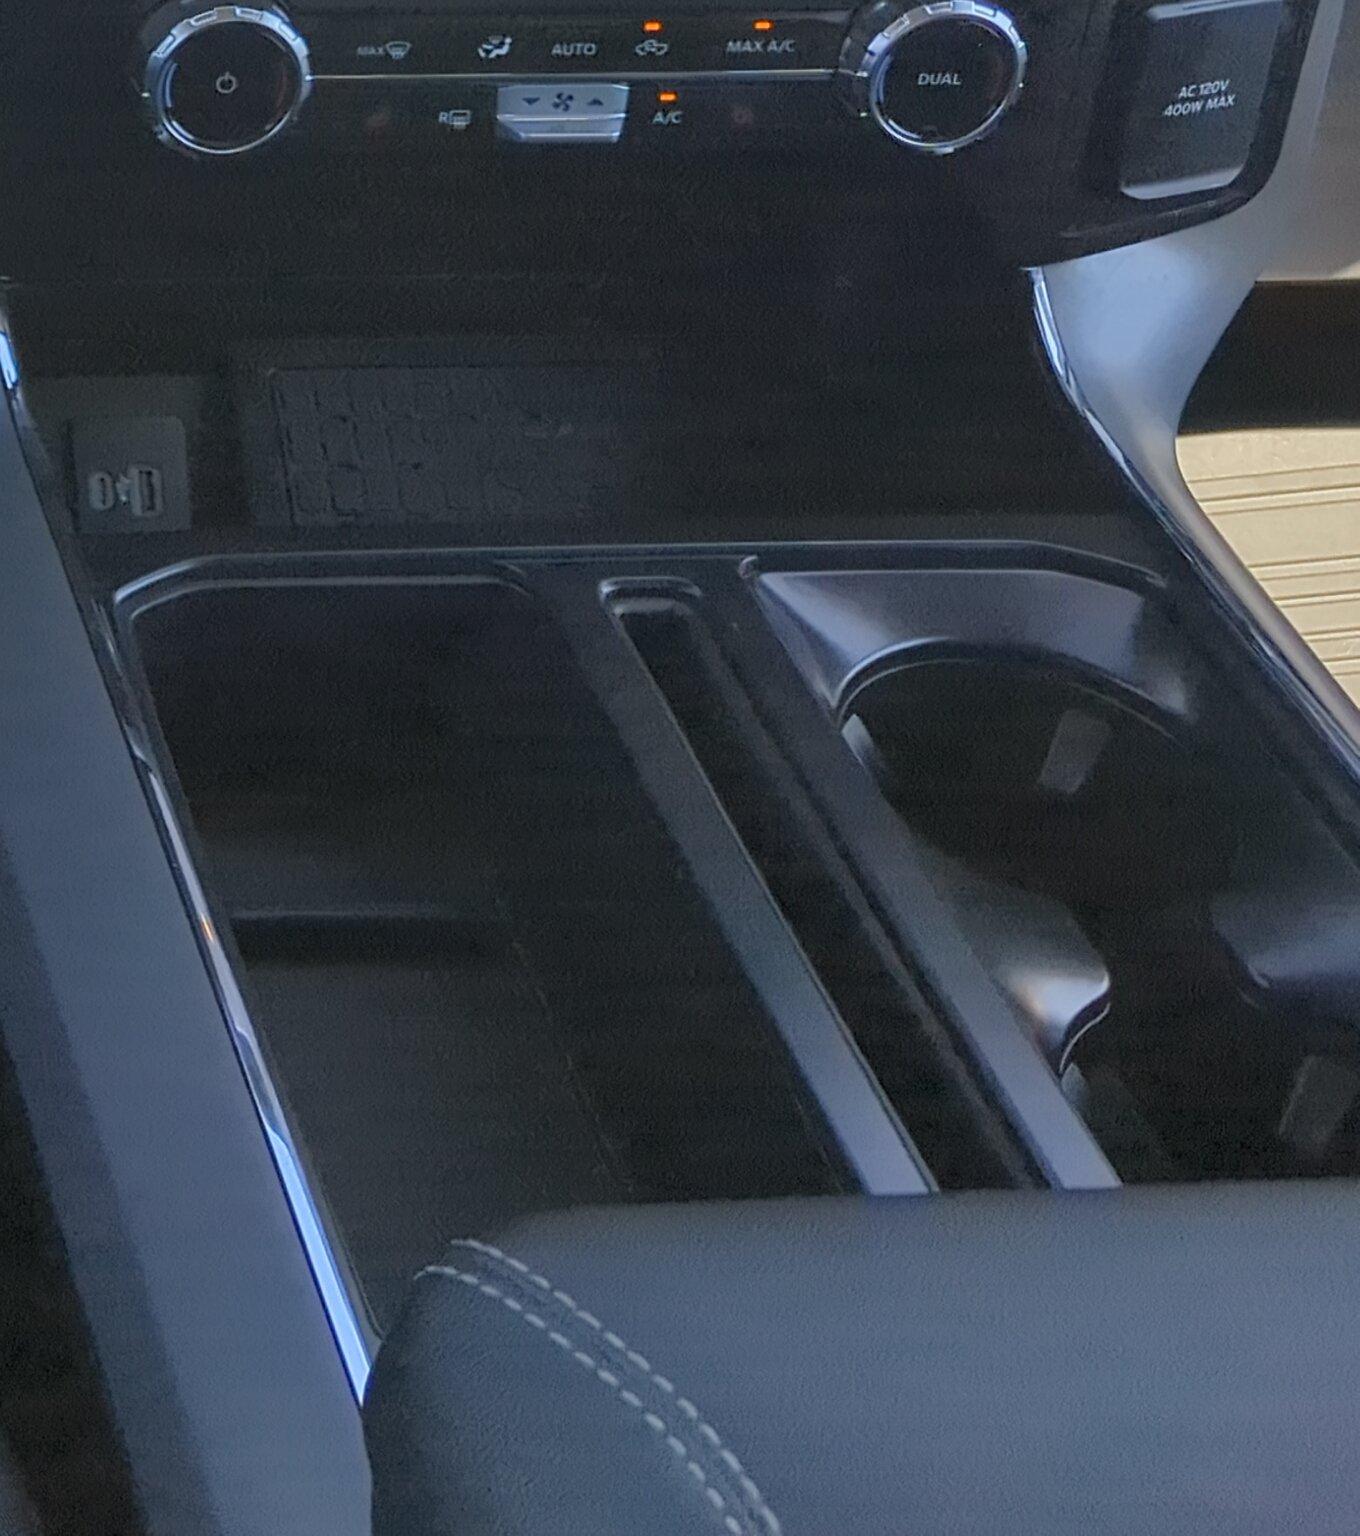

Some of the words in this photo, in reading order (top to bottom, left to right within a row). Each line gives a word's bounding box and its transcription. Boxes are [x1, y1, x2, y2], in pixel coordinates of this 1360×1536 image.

[551, 43, 597, 56] AUTO
[726, 40, 762, 53] MAX
[766, 39, 796, 53] A/C
[917, 72, 961, 86] DUAL
[1179, 84, 1198, 99] AC
[1199, 80, 1230, 96] 120V
[1163, 100, 1204, 117] 400W
[1205, 96, 1235, 110] MAX
[652, 111, 682, 125] A/C
